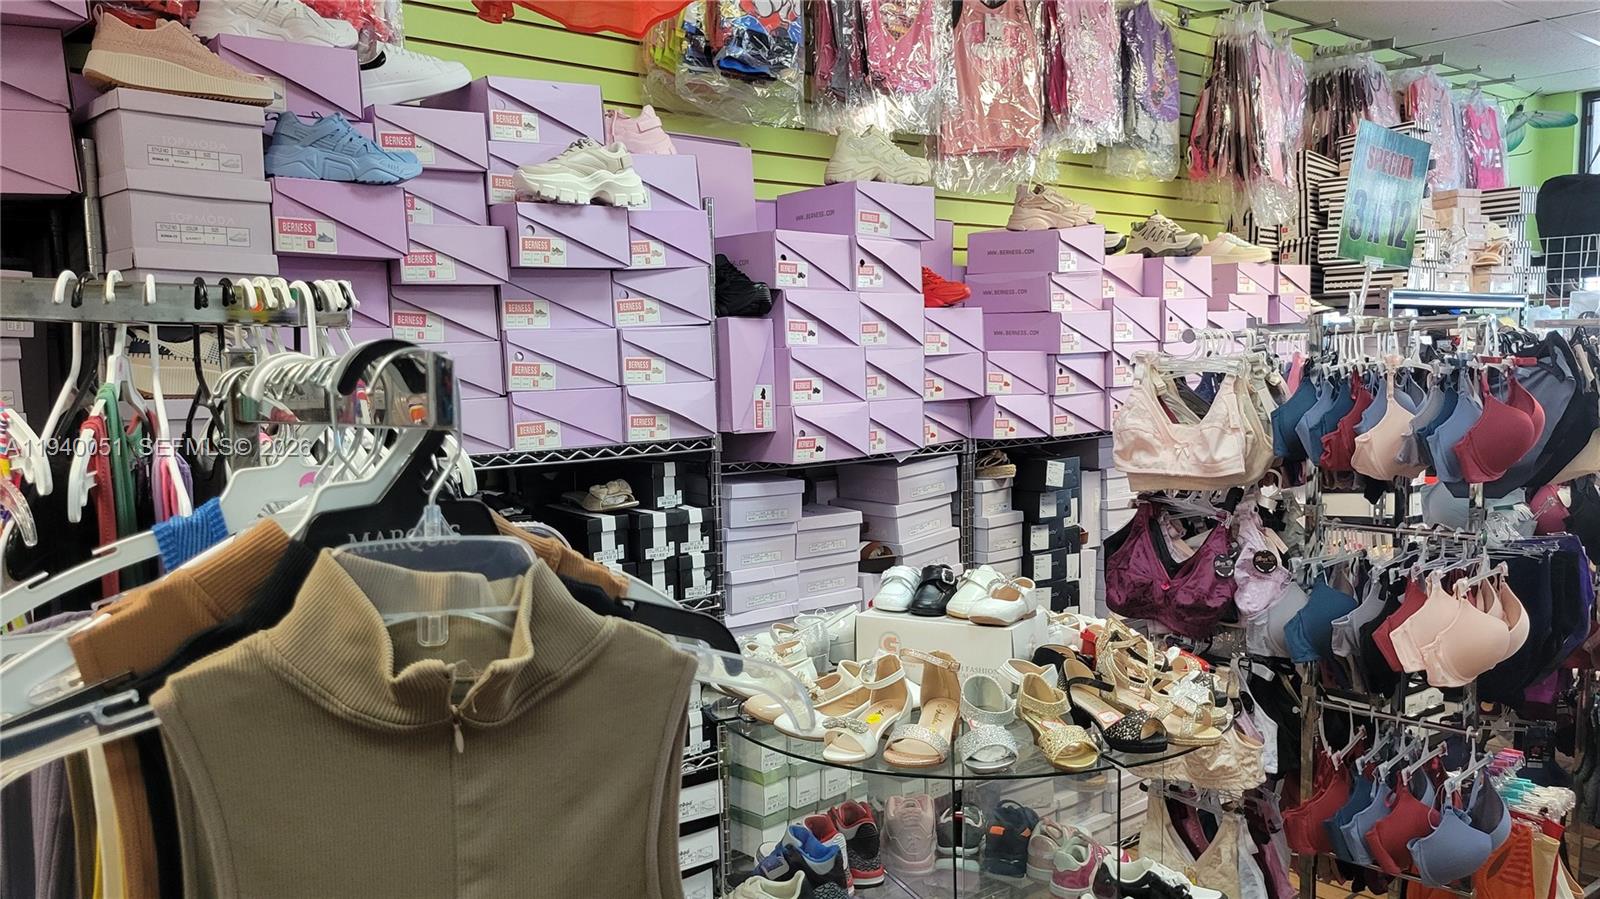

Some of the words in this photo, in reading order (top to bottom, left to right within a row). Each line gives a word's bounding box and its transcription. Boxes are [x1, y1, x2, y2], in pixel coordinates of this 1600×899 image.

[495, 114, 520, 125] BERNESS
[384, 135, 412, 146] BERNESS
[1367, 146, 1414, 181] SPECIAL
[1349, 189, 1368, 241] 3
[1387, 199, 1413, 250] 12
[282, 222, 313, 233] BERNESS
[525, 240, 548, 250] BERNESS
[407, 254, 433, 264] BERNESS
[508, 303, 532, 312] BERNESS
[619, 302, 642, 311] BERNESS
[397, 315, 424, 325] BERNESS
[628, 360, 649, 369] BERNESS
[514, 366, 538, 375] BERNESS
[633, 417, 654, 426] BERNESS
[519, 424, 543, 434] BERNESS
